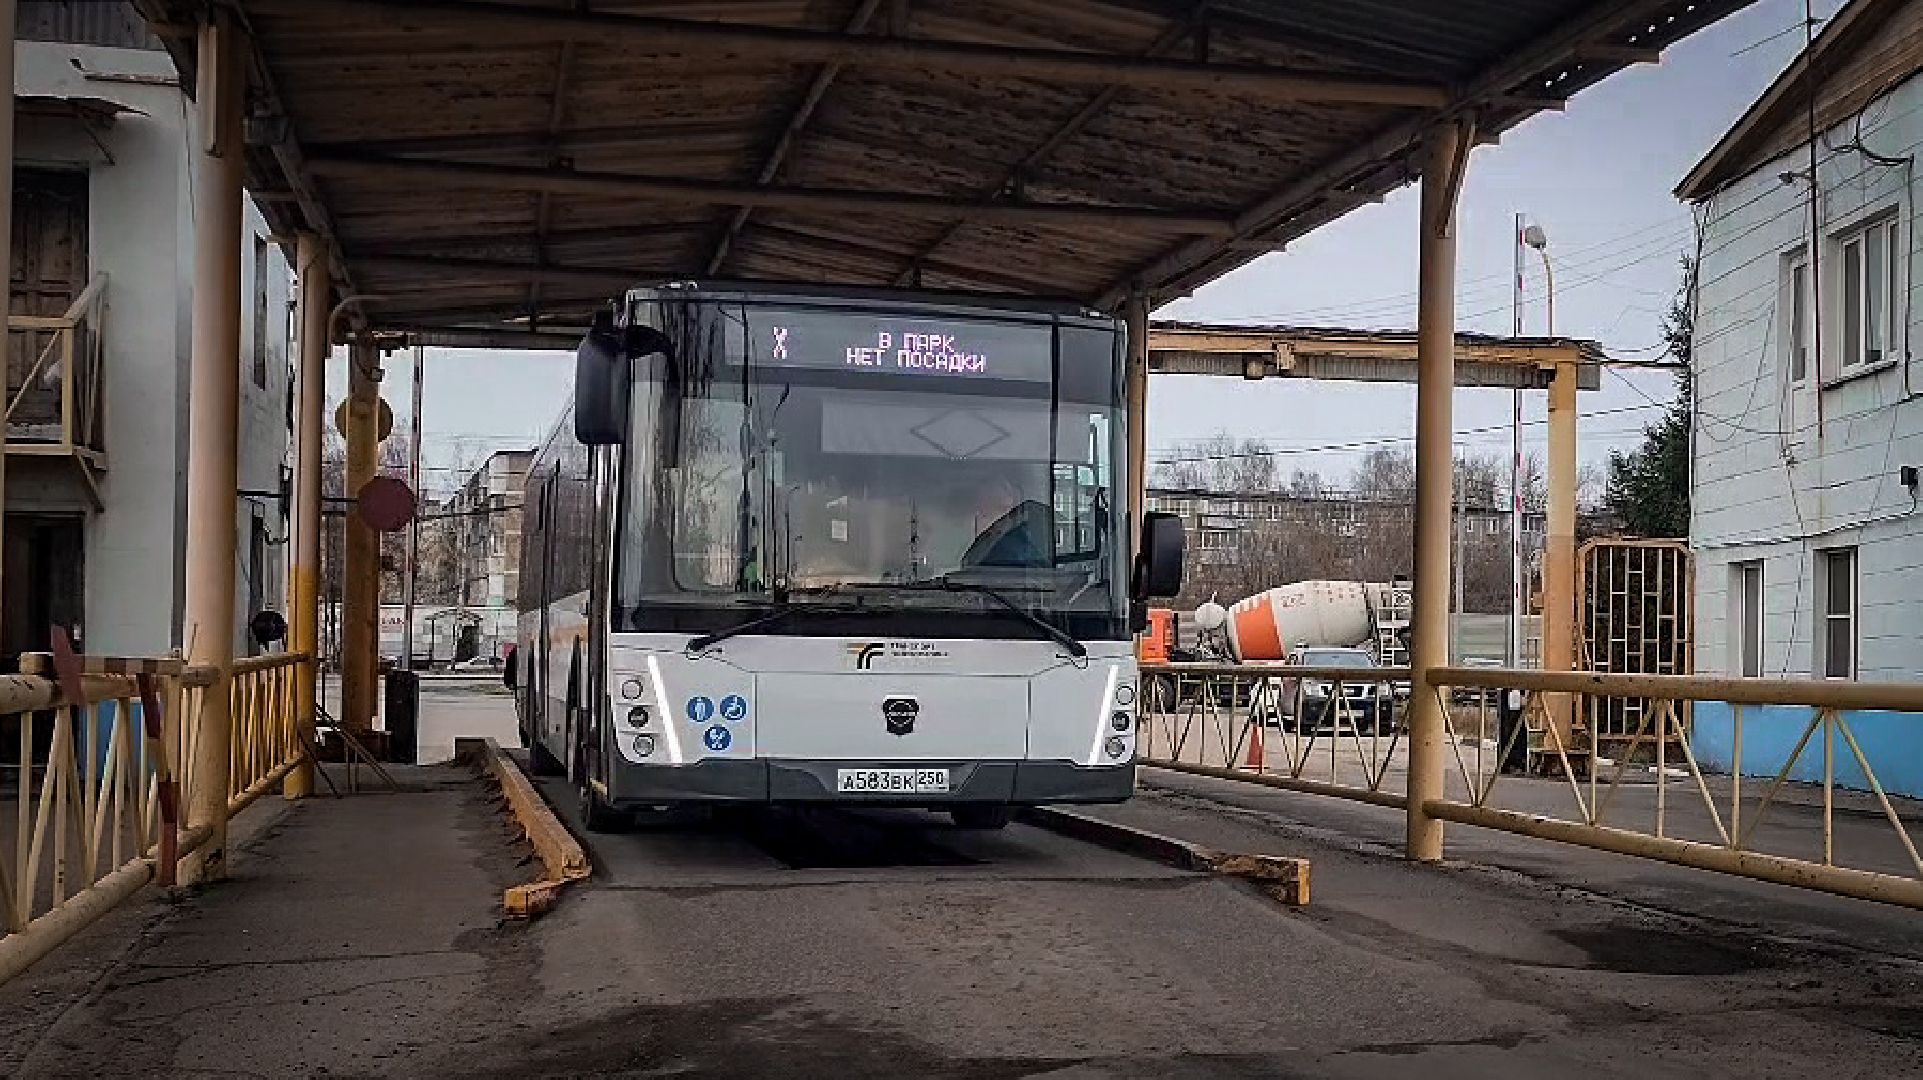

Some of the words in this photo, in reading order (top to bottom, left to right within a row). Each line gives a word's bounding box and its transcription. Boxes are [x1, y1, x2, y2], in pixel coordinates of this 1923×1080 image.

[878, 332, 892, 349] В
[903, 333, 955, 352] ПАРК
[846, 347, 885, 366] НЕТ
[897, 349, 986, 373] ПОСАДКИ
[918, 771, 944, 785] 250
